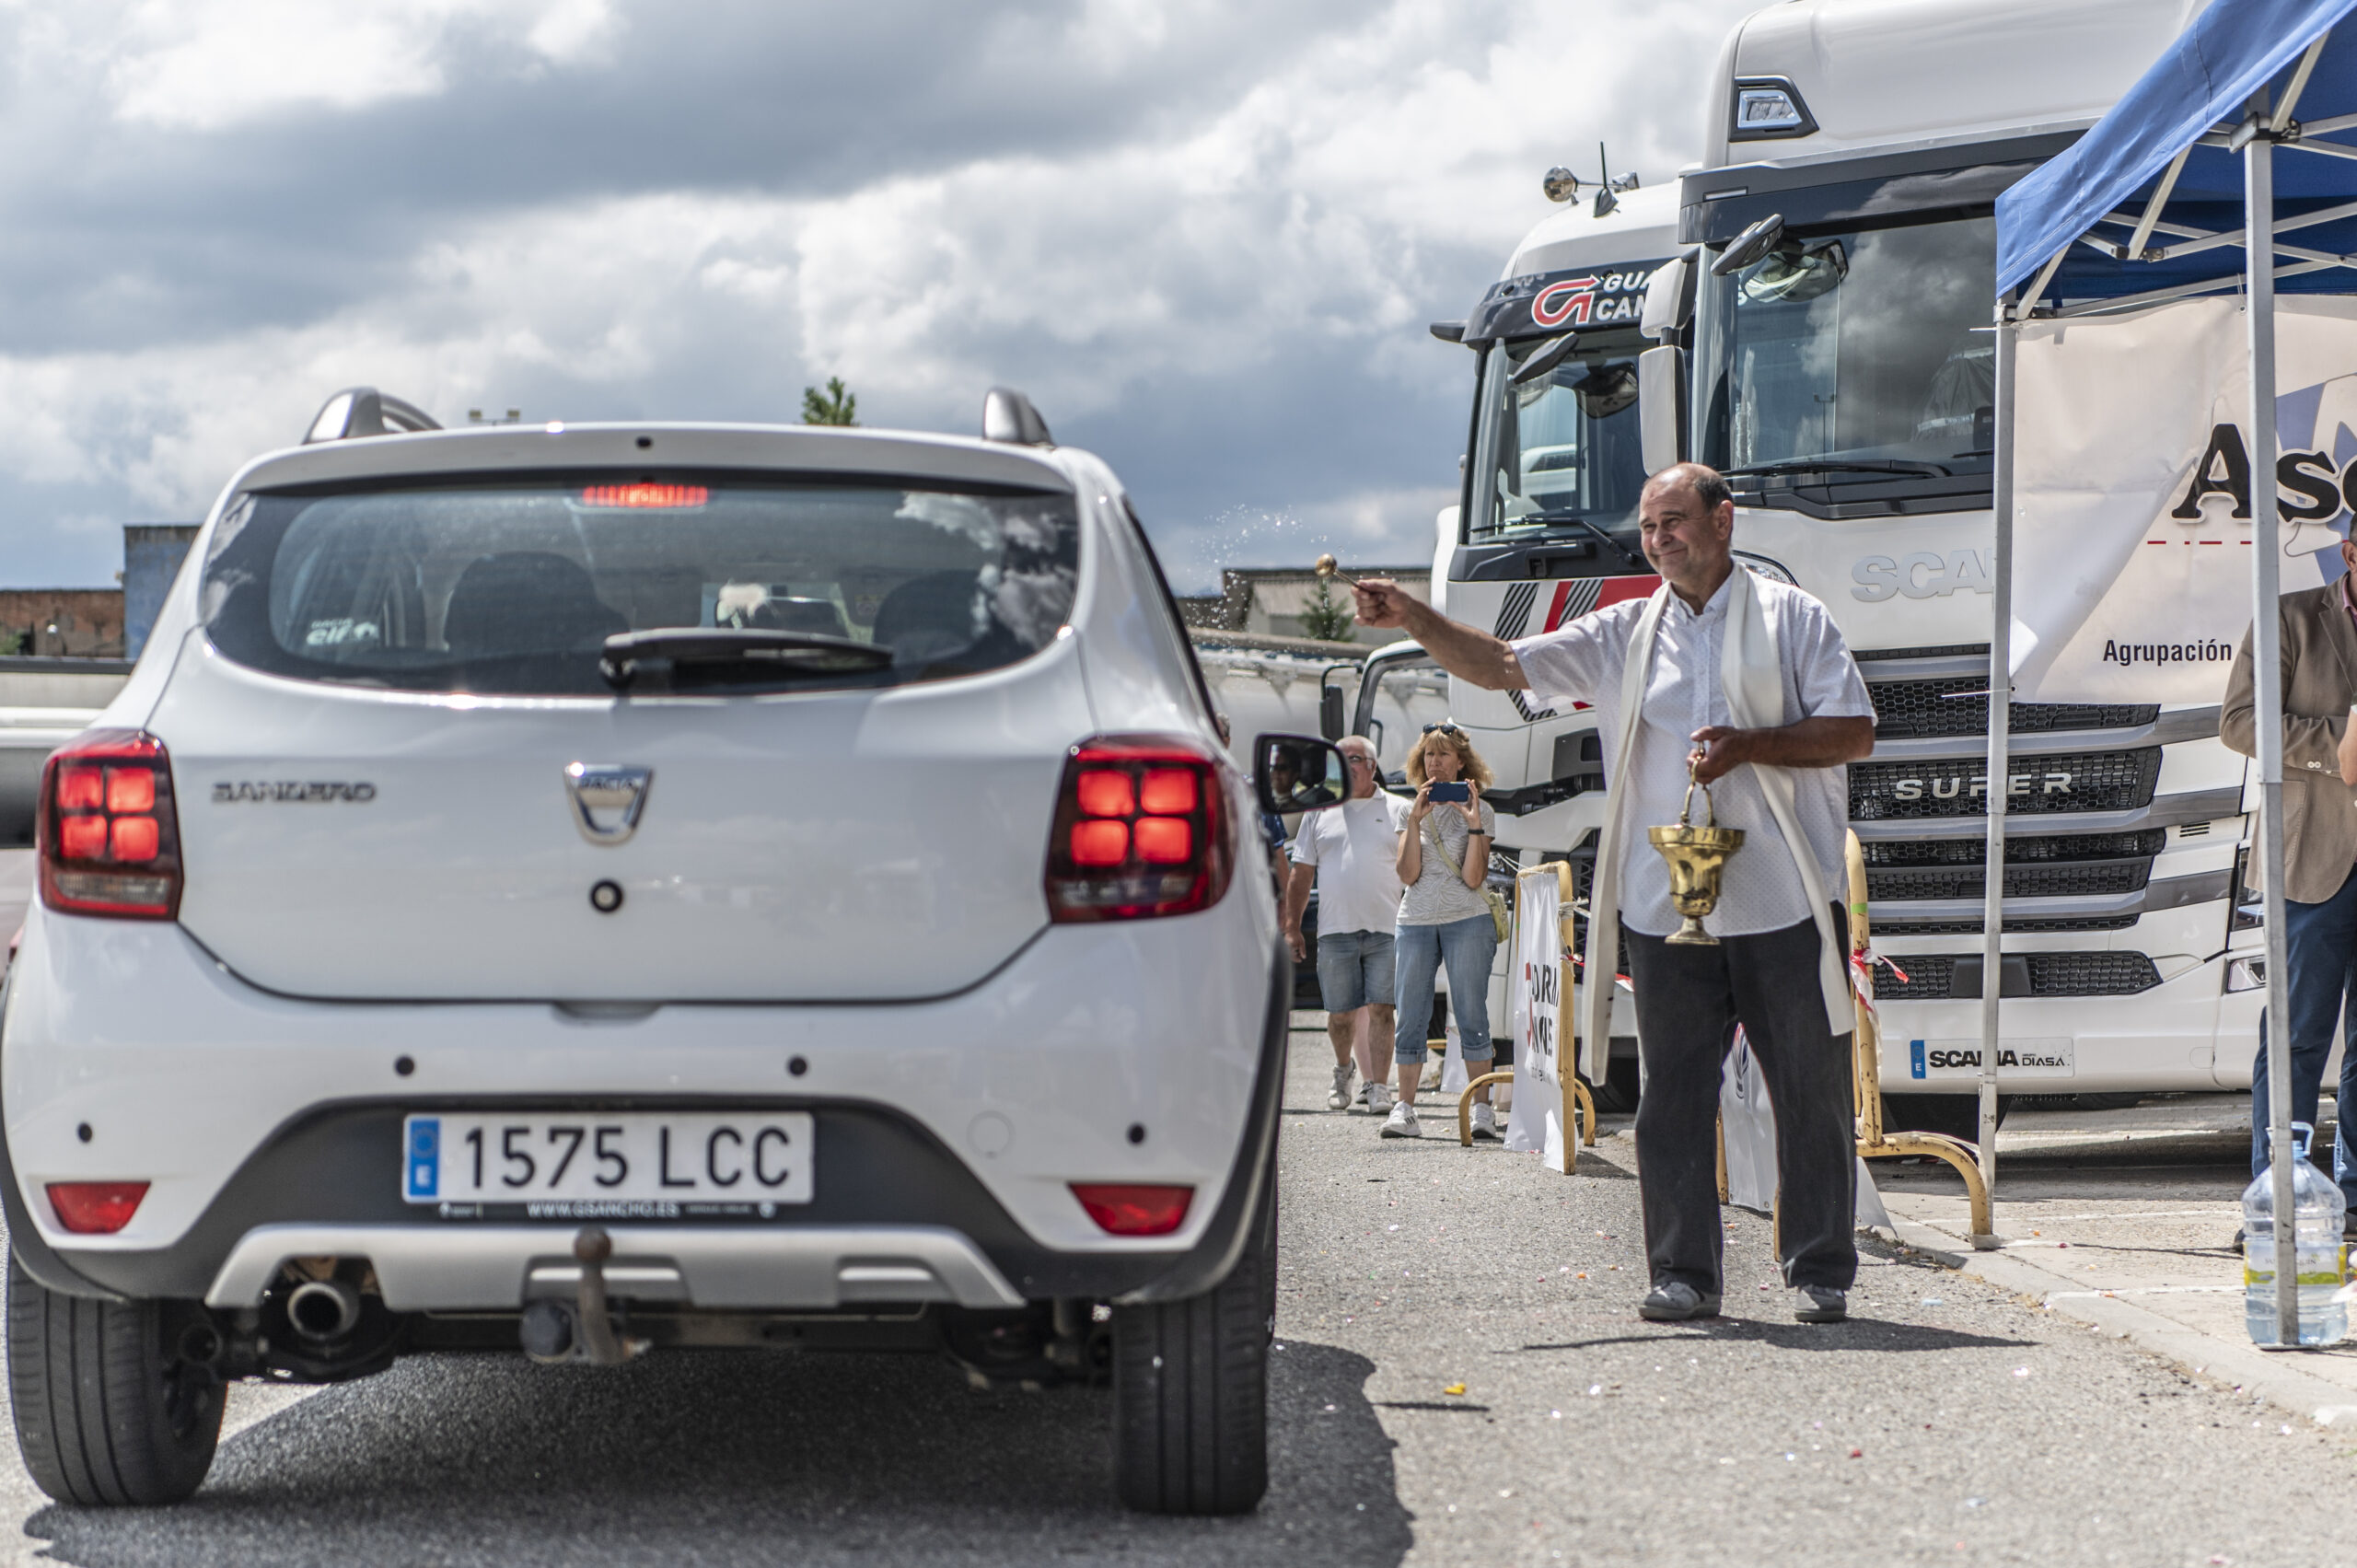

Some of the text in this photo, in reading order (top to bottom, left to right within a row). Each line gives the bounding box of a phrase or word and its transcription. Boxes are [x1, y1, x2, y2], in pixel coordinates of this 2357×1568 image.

[2171, 424, 2357, 522] As
[1850, 549, 1995, 603] SCA
[2103, 639, 2232, 667] Agrupación
[212, 782, 377, 803] SANDERO
[1915, 1050, 2065, 1072] E SCAIA DIASA
[414, 1124, 791, 1190] E 1575 LCC
